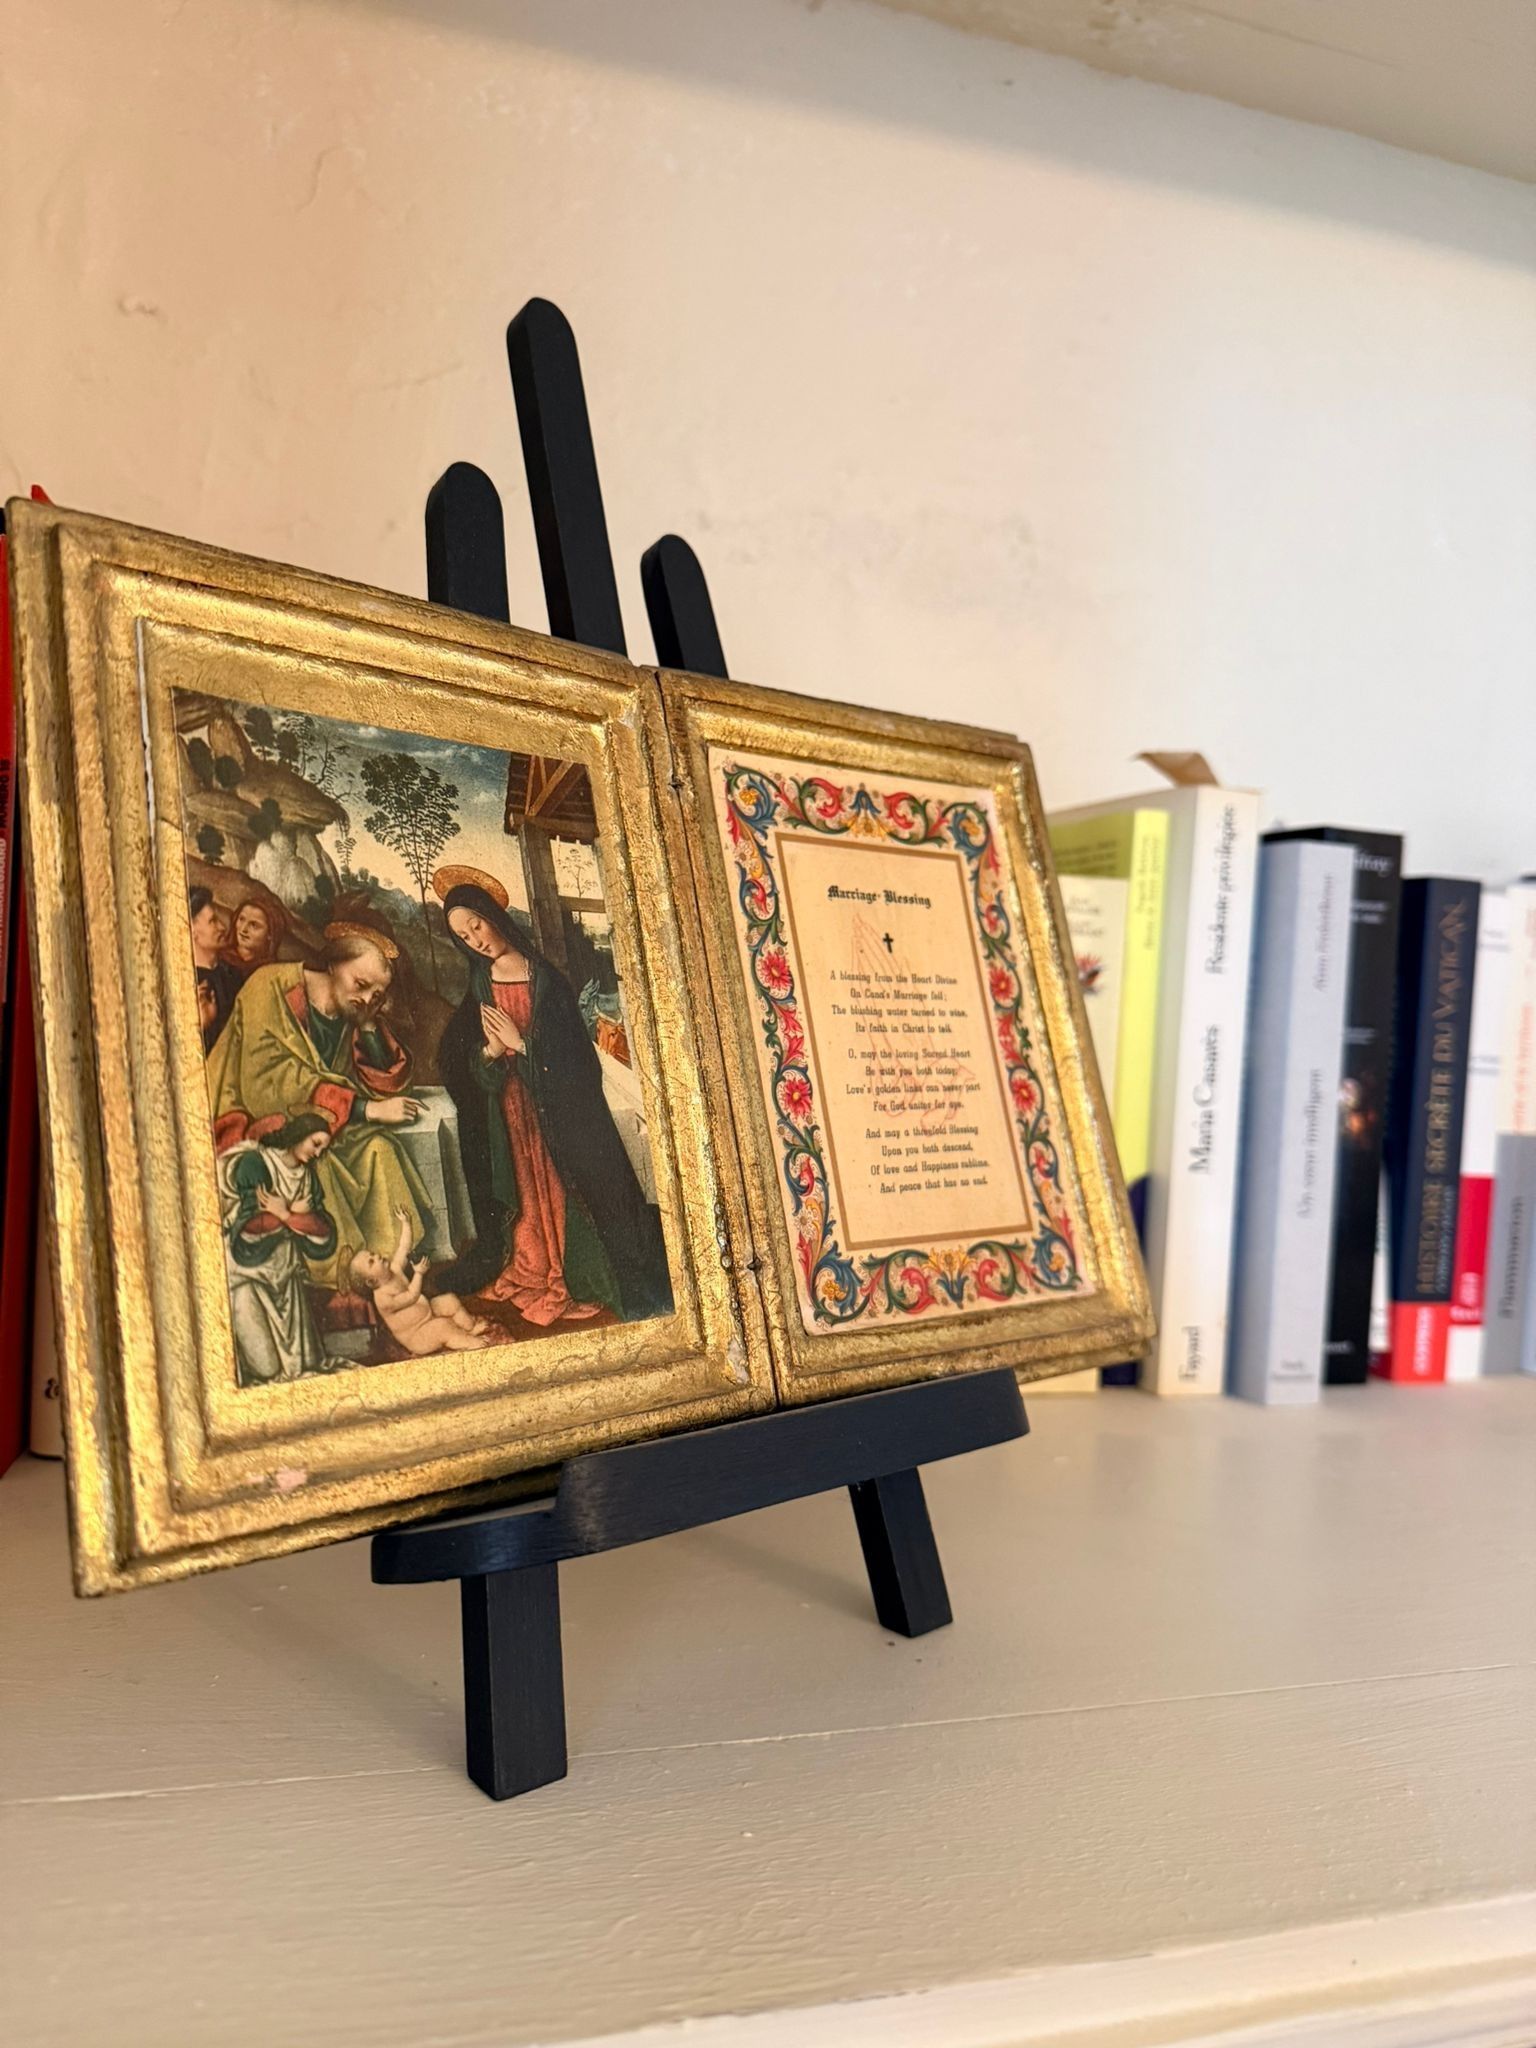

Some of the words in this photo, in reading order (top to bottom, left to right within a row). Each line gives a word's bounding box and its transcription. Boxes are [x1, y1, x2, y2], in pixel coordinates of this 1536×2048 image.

[827, 885, 877, 904] Marriage
[883, 889, 931, 909] Blessing
[1432, 901, 1467, 1020] VATICAN
[830, 970, 836, 980] A
[840, 970, 871, 984] blessing
[875, 972, 893, 983] from
[896, 972, 908, 984] the
[911, 973, 932, 984] Heart
[935, 974, 958, 985] Divine
[850, 988, 861, 999] On
[893, 989, 927, 1001] Marriage
[831, 1004, 846, 1015] The
[850, 1005, 883, 1017] blushing
[886, 1008, 908, 1016] water
[911, 1007, 935, 1017] turned
[938, 1008, 946, 1017] to
[855, 1022, 866, 1033] Its
[869, 1022, 888, 1033] faith
[891, 1024, 899, 1033] in
[902, 1023, 925, 1033] Christ
[928, 1024, 935, 1033] to
[1432, 1022, 1456, 1062] DU
[860, 1049, 877, 1060] may
[879, 1049, 892, 1058] the
[895, 1048, 919, 1060] loving
[921, 1048, 948, 1058] Sacred
[950, 1048, 971, 1058] Heart
[865, 1065, 875, 1076] Be
[879, 1066, 896, 1076] with
[899, 1068, 912, 1078] you
[916, 1066, 932, 1075] both
[846, 1084, 872, 1094] Love's
[875, 1083, 901, 1095] golden
[904, 1083, 922, 1093] links
[942, 1084, 962, 1092] never
[965, 1082, 981, 1093] part
[873, 1101, 887, 1111] For
[908, 1101, 931, 1110] unites
[935, 1099, 945, 1109] for
[866, 1128, 881, 1139] And
[885, 1129, 900, 1139] may
[913, 1125, 946, 1136] threefold
[949, 1124, 978, 1135] Blessing
[1189, 1107, 1216, 1174] Maria
[882, 1145, 902, 1156] Upon
[905, 1147, 918, 1156] you
[923, 1143, 939, 1153] both
[870, 1164, 881, 1175] Of
[884, 1163, 899, 1174] love
[903, 1162, 918, 1172] and
[921, 1160, 959, 1172] Happiness
[880, 1182, 895, 1193] And
[899, 1183, 921, 1193] peace
[925, 1178, 940, 1189] that
[944, 1178, 957, 1187] has
[1416, 1181, 1442, 1293] HISTOIRE
